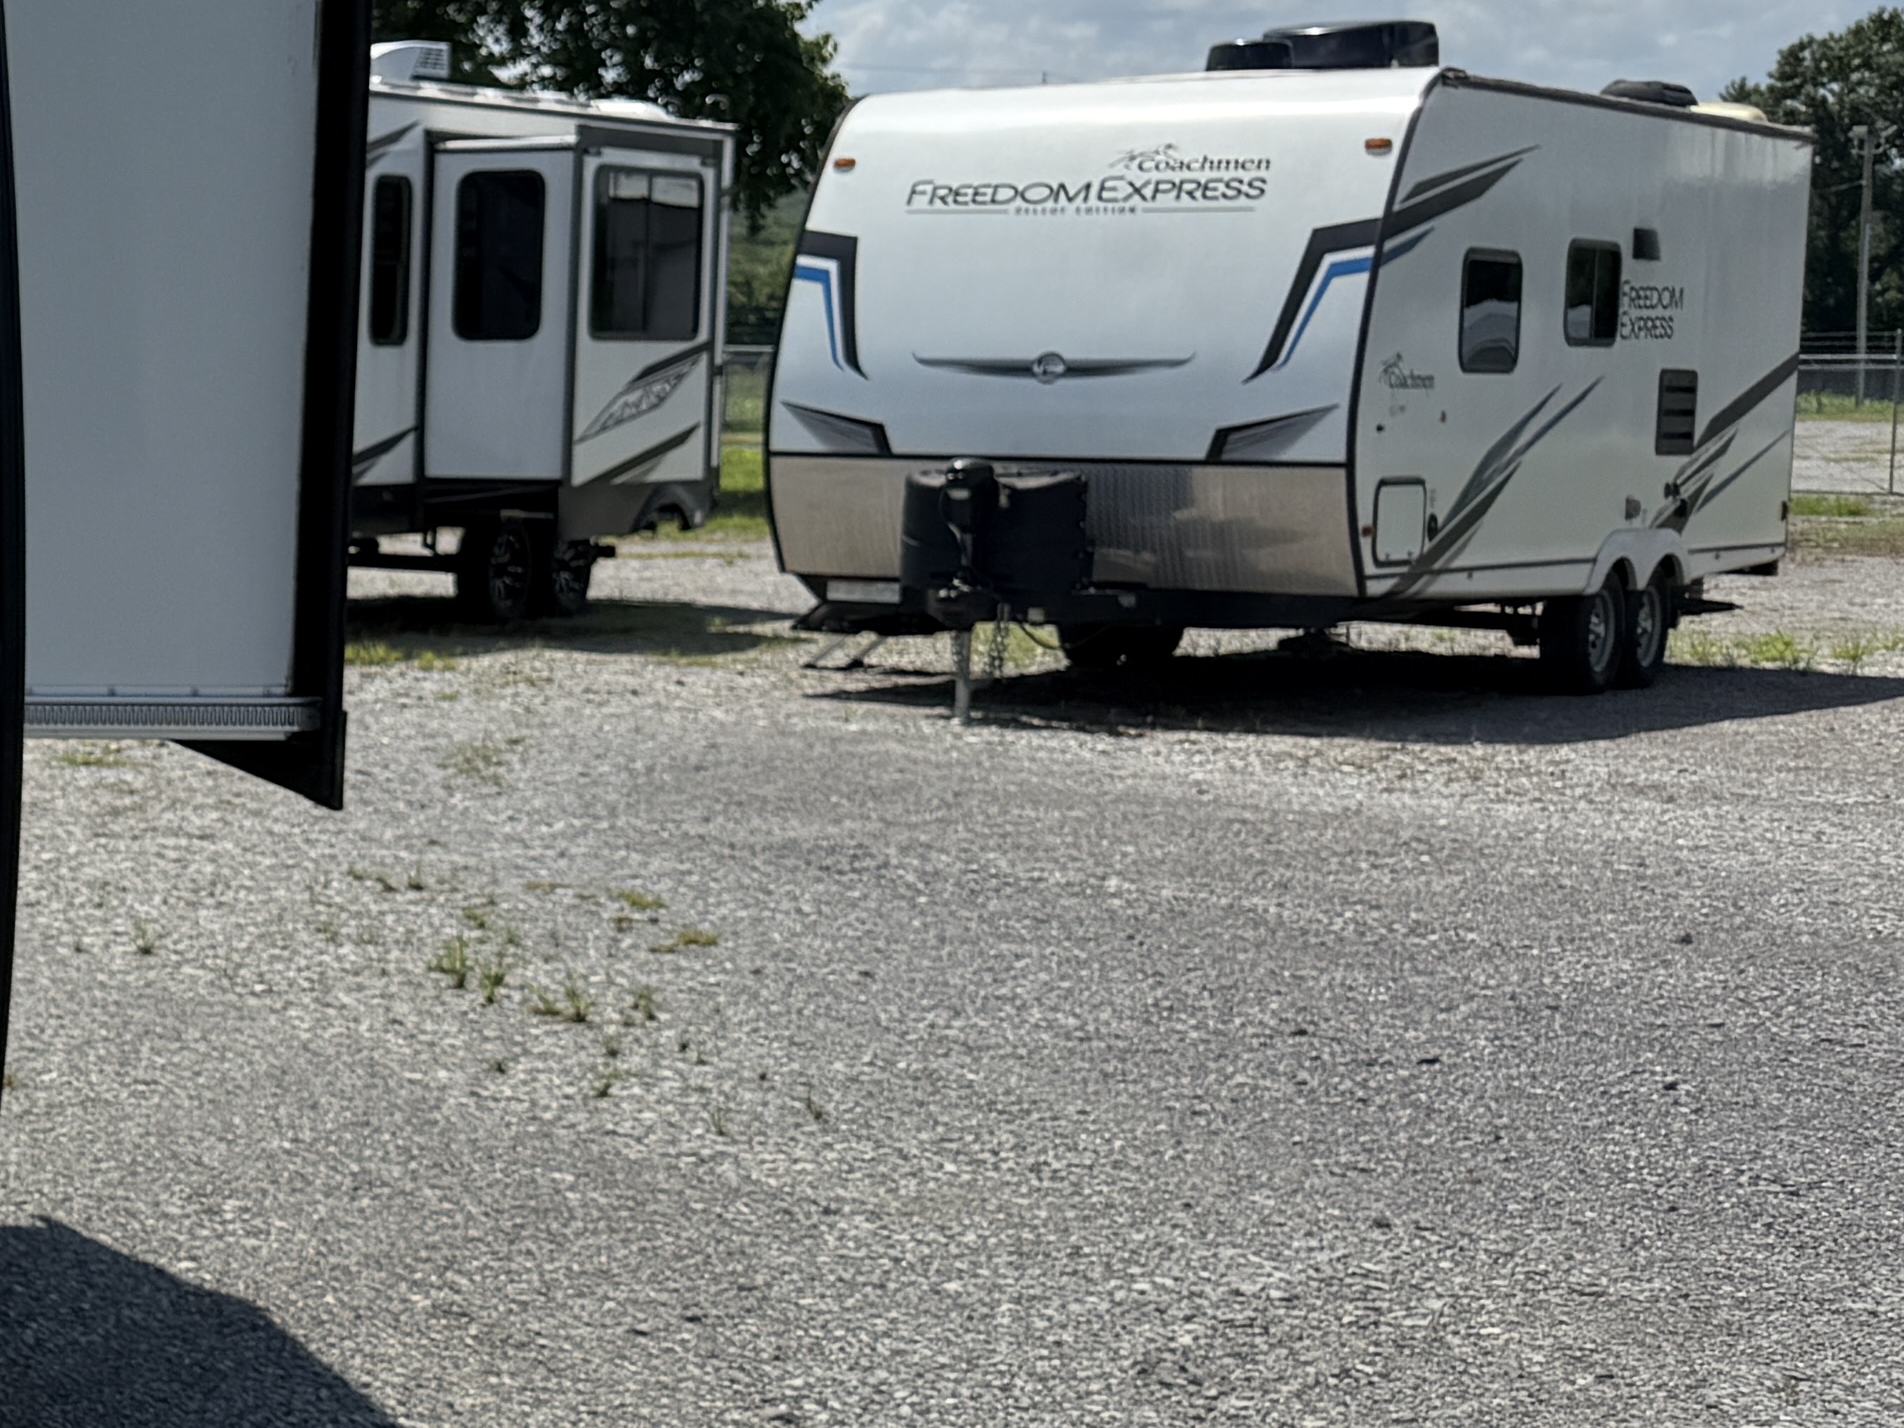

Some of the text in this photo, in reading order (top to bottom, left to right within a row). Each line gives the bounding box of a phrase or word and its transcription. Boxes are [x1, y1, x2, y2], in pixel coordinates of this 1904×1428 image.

[1137, 154, 1272, 174] Coachmen
[906, 175, 1267, 207] FREEDOM EXPRESS
[1622, 279, 1685, 312] FREEDOM
[1620, 310, 1675, 341] EXPRESS
